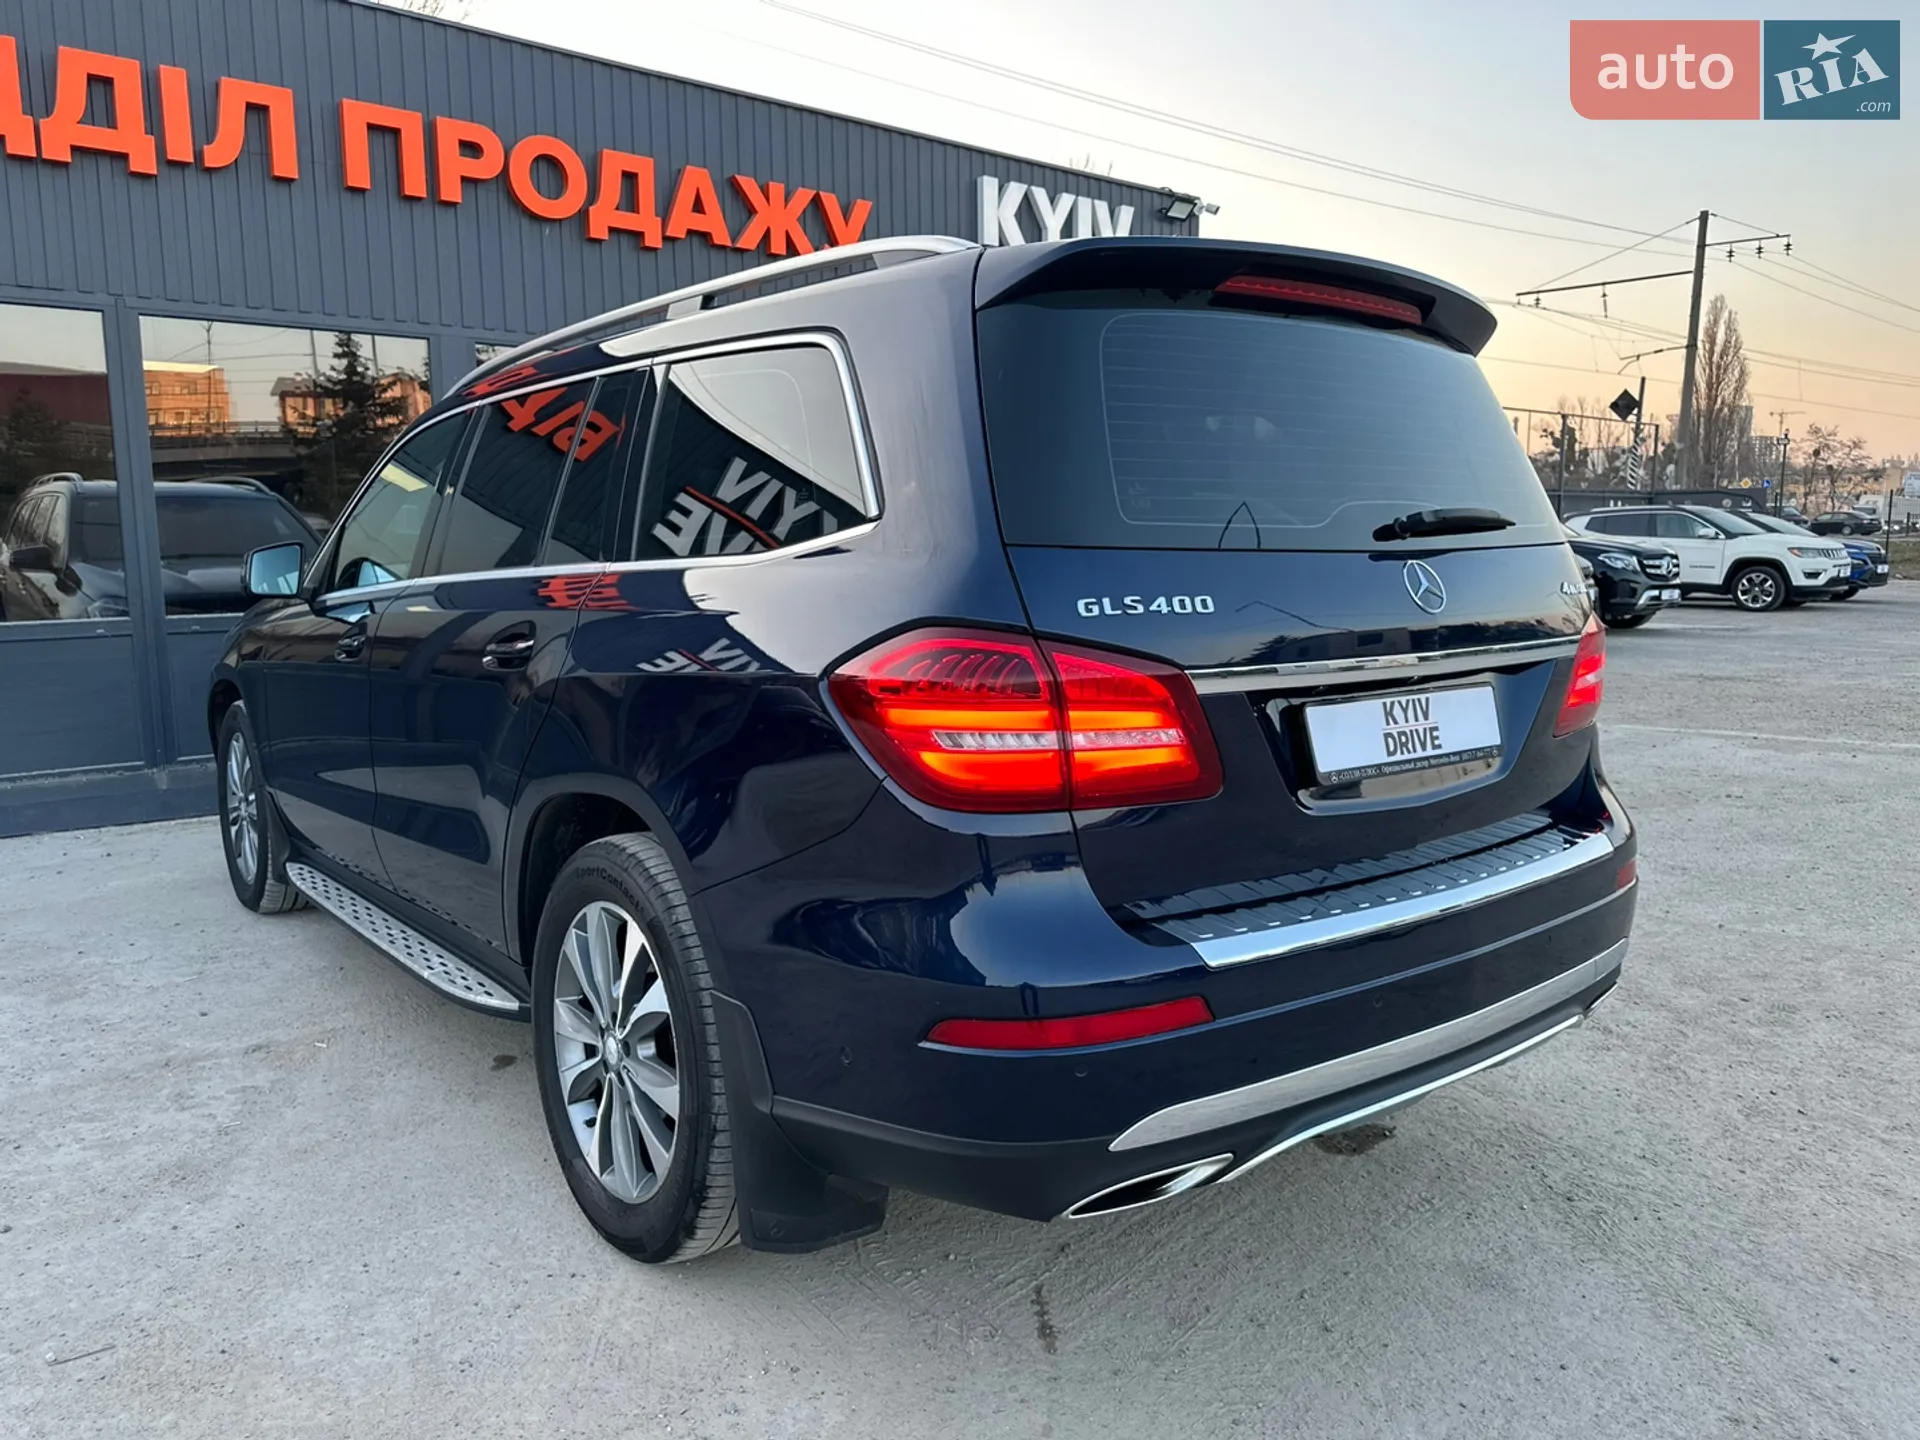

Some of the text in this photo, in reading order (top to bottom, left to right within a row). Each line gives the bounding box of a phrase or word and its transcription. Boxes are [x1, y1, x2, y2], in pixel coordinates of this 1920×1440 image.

[339, 96, 873, 256] ПРОДАЖУ
[976, 174, 1135, 247] KYIV
[1382, 696, 1430, 726] KYIV
[1383, 725, 1443, 758] DRIVE
